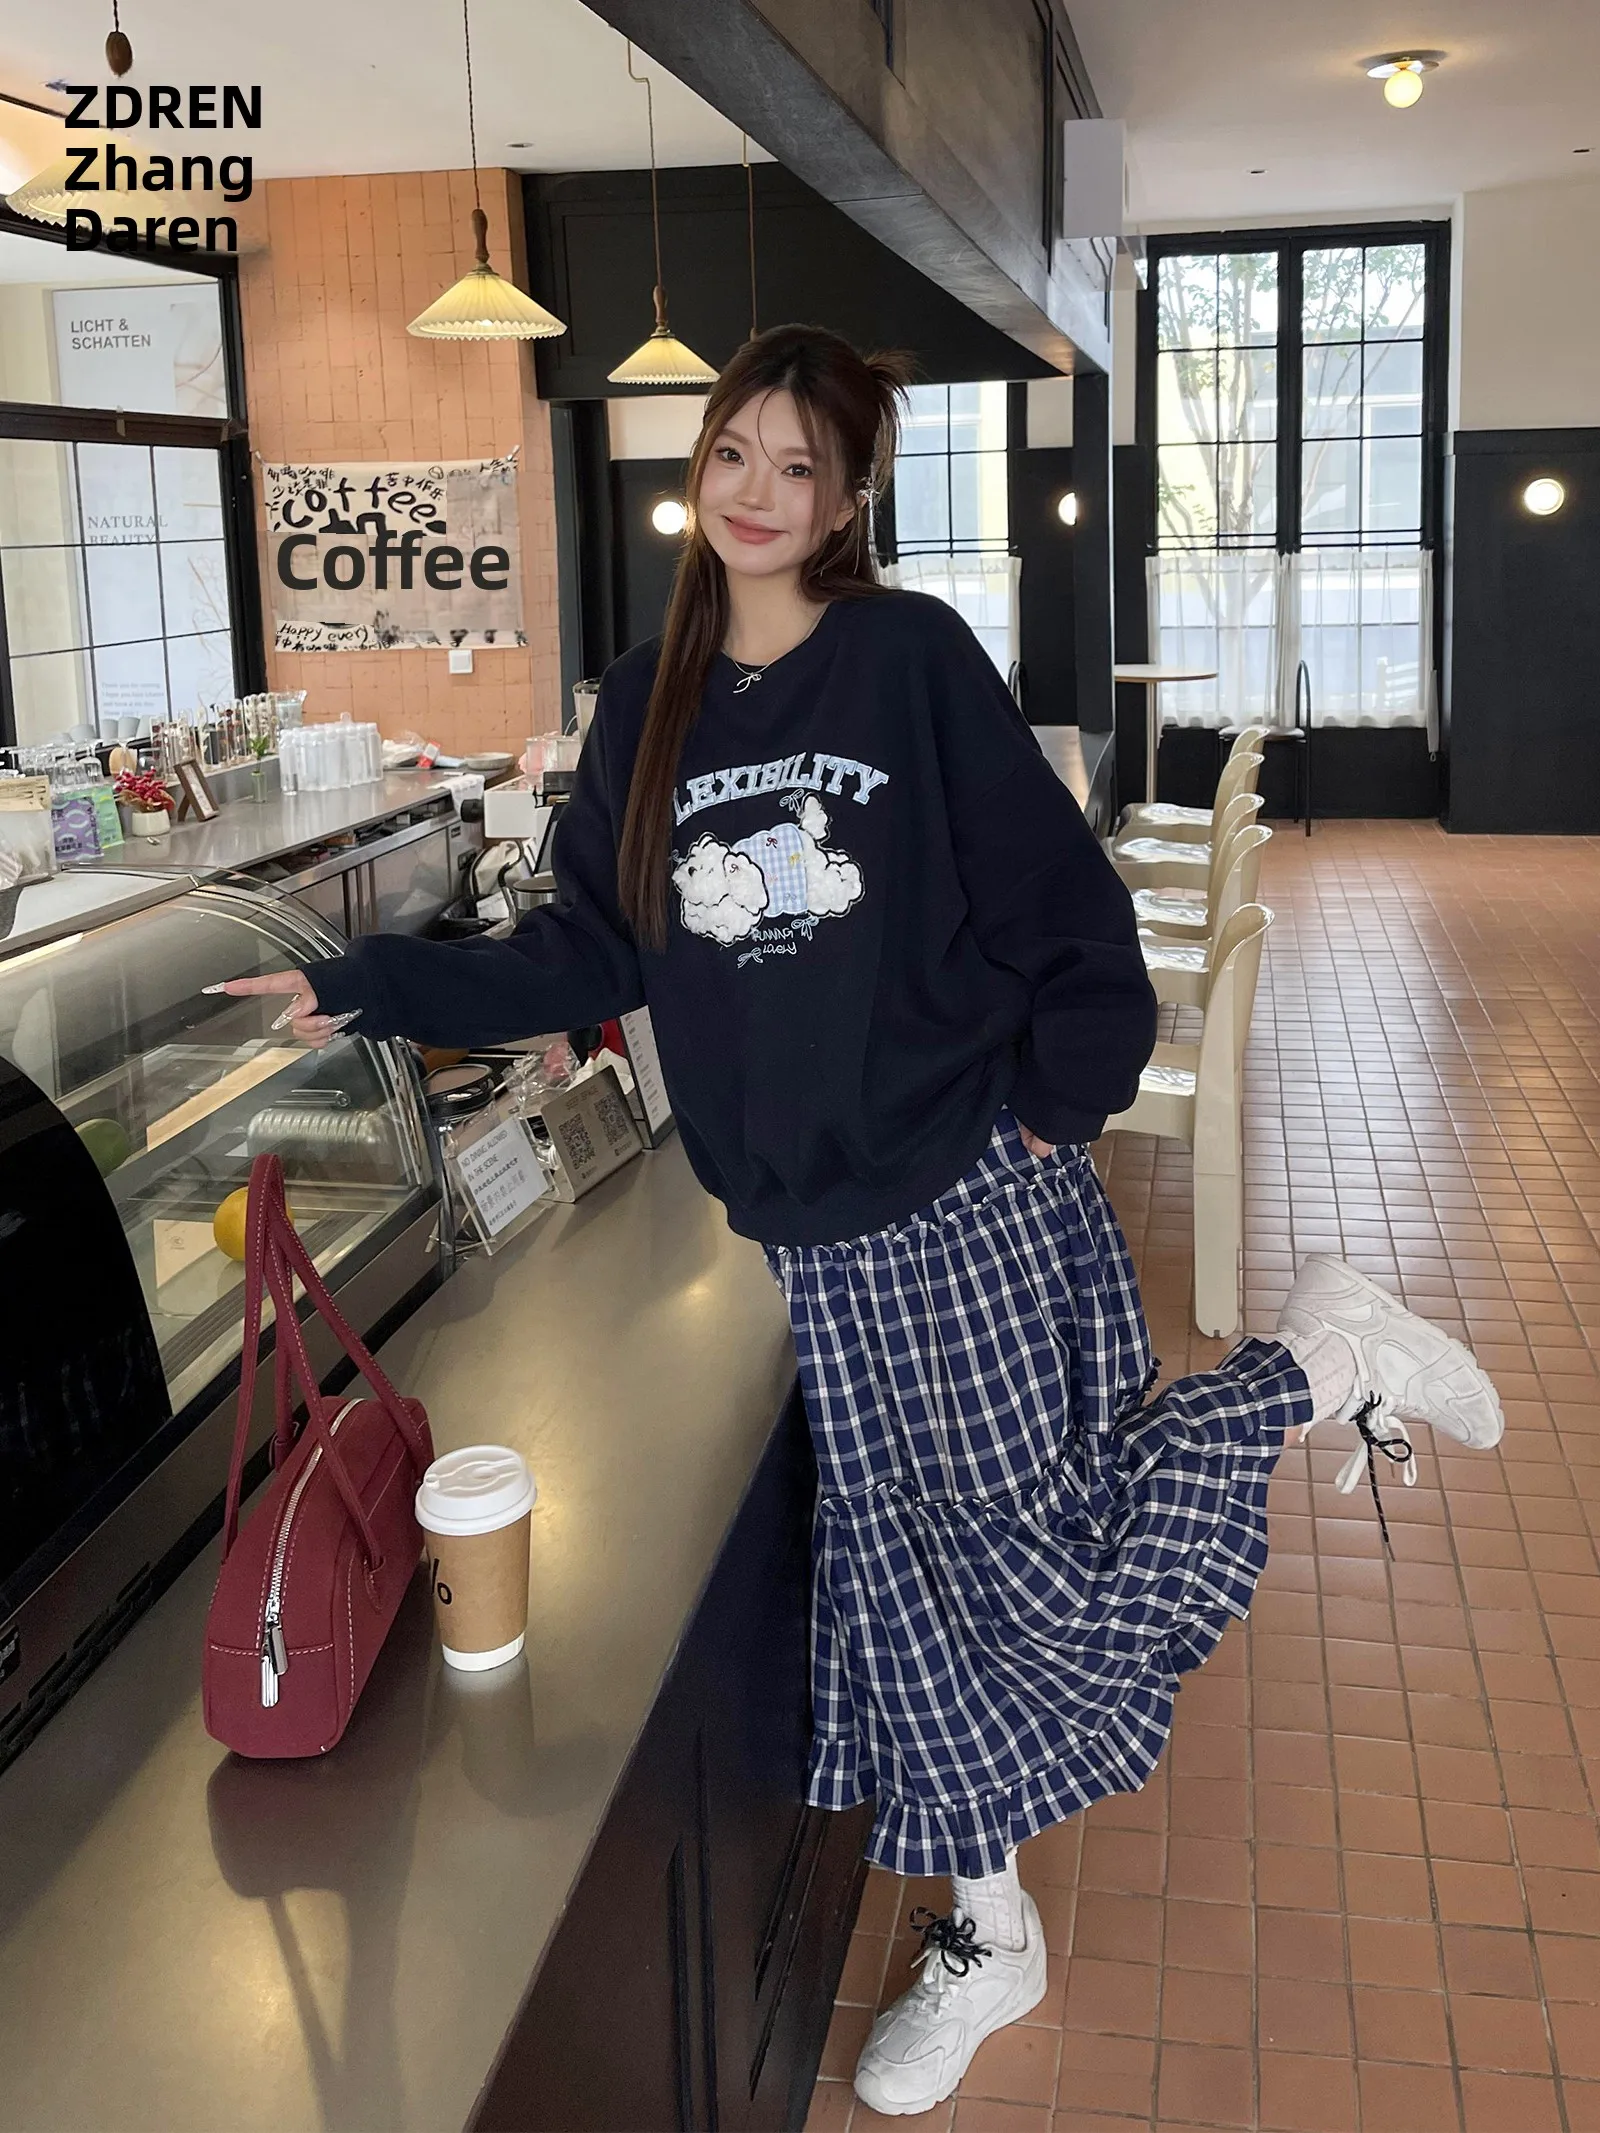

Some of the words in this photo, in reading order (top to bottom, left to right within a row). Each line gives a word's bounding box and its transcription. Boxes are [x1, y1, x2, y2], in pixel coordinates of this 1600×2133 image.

[71, 319, 114, 333] LICHT
[119, 318, 129, 331] &
[72, 334, 151, 350] SCHATTEN
[87, 515, 168, 528] NATURAL
[673, 752, 890, 826] LEXIBILITY
